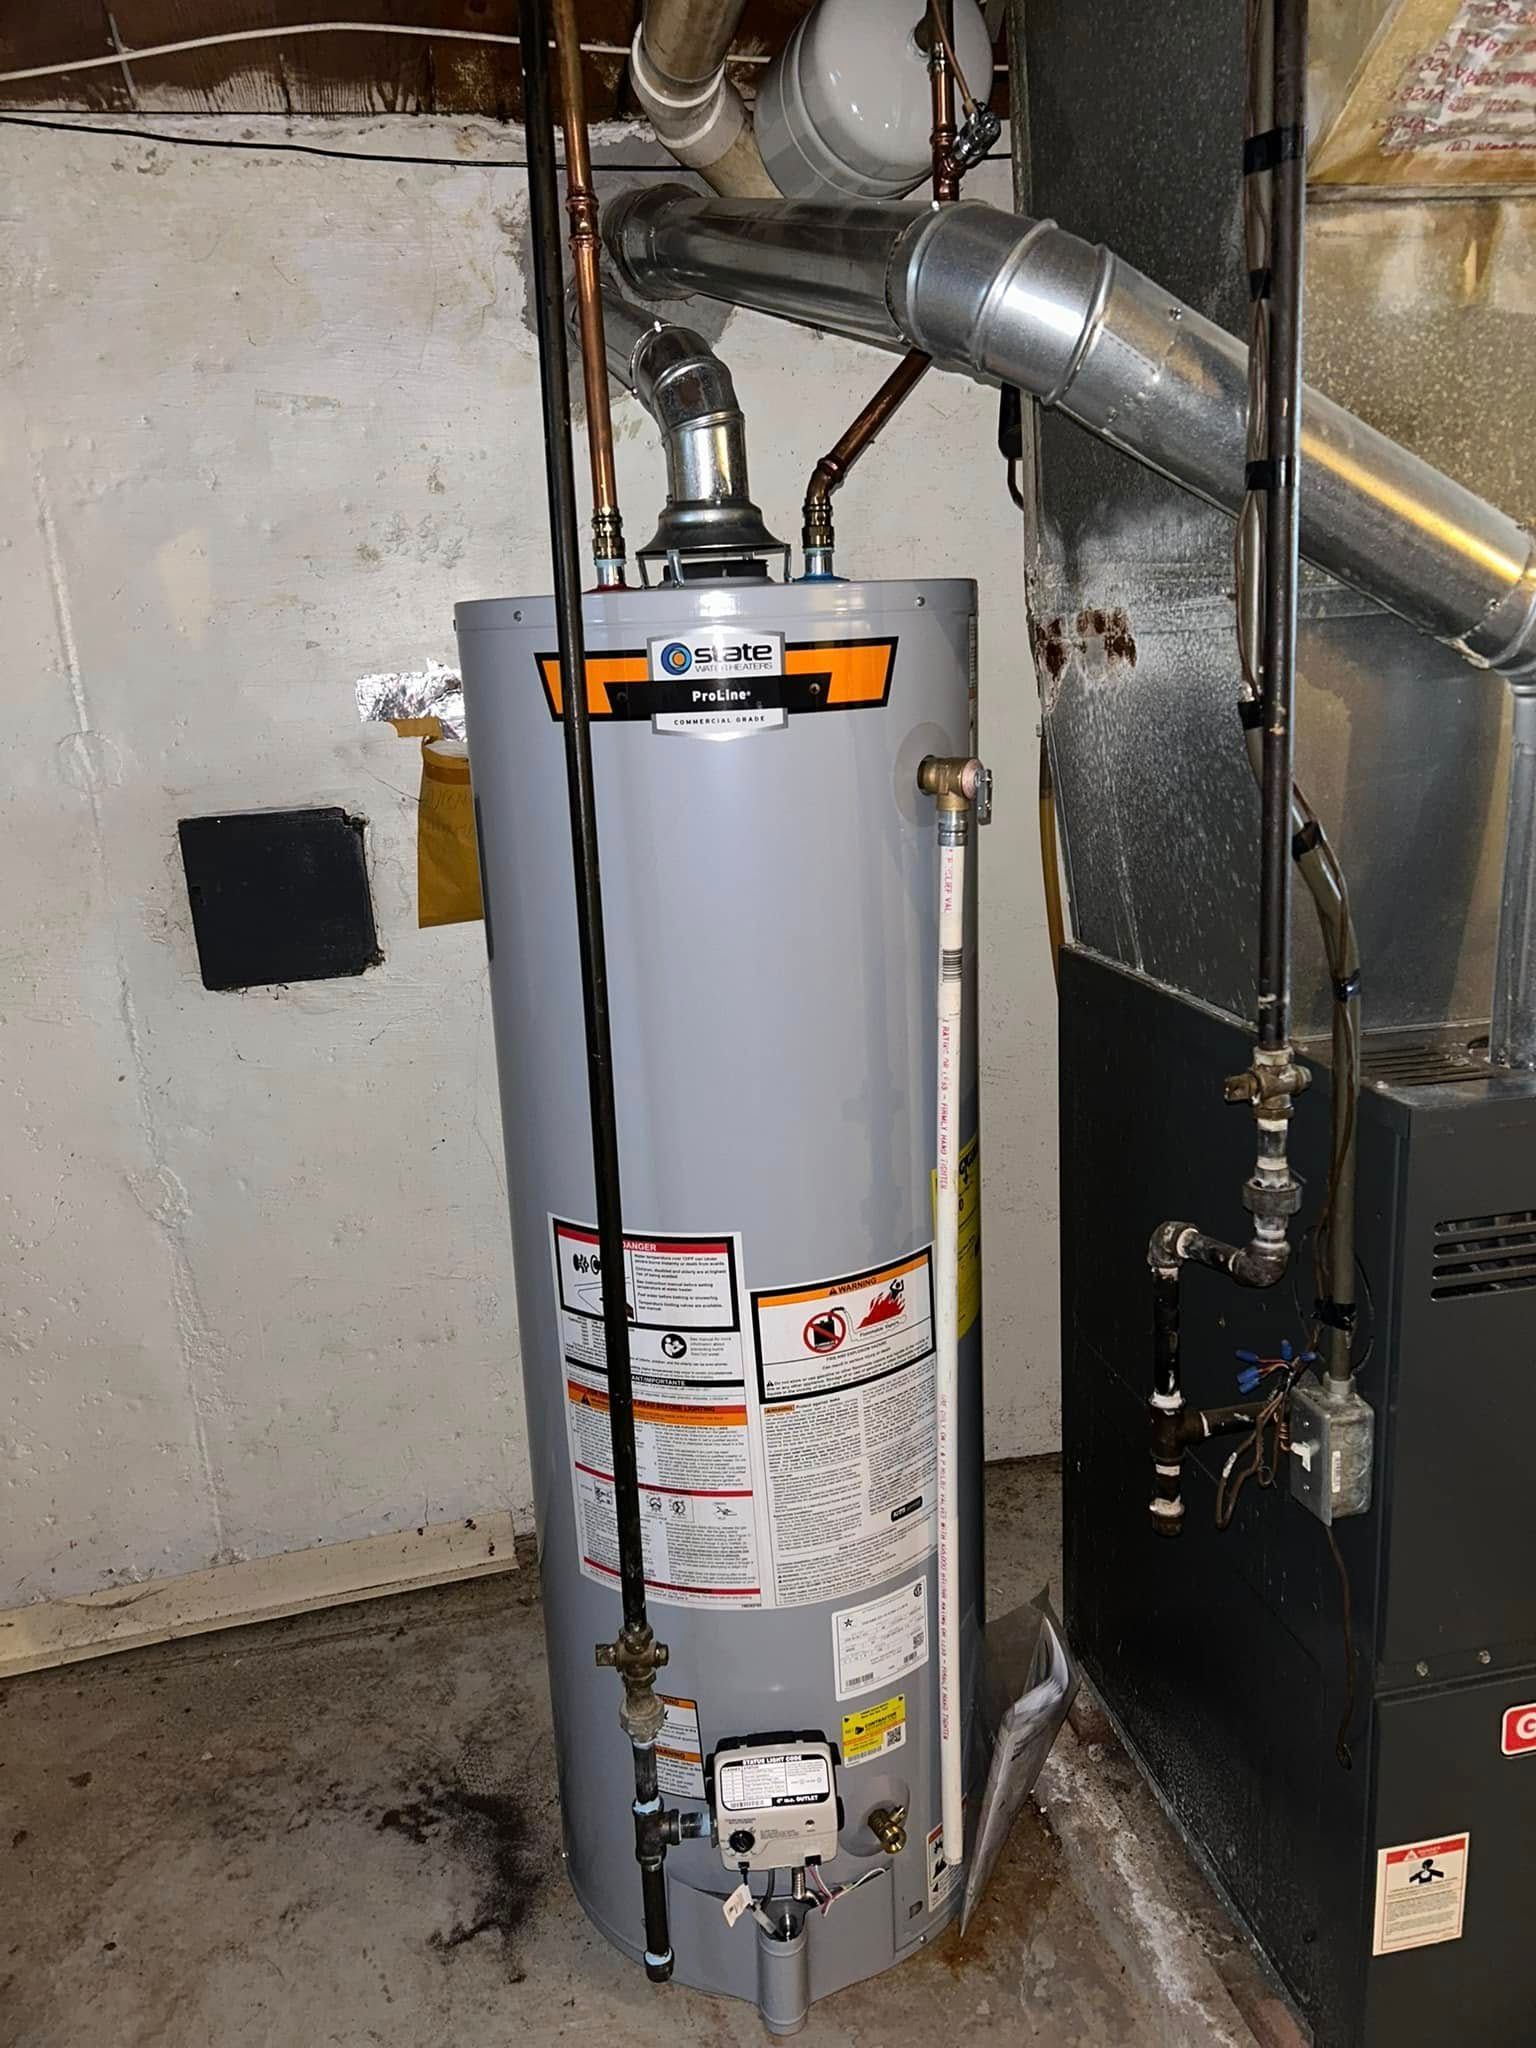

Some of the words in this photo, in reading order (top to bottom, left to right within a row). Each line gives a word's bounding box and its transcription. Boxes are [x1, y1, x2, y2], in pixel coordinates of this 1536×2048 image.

[694, 643, 772, 663] state
[673, 716, 731, 726] COMMERCIAL
[736, 715, 765, 723] GRADE
[940, 1103, 950, 1131] FIRMLY
[940, 1134, 950, 1155] HAND
[839, 1277, 877, 1293] WARNING
